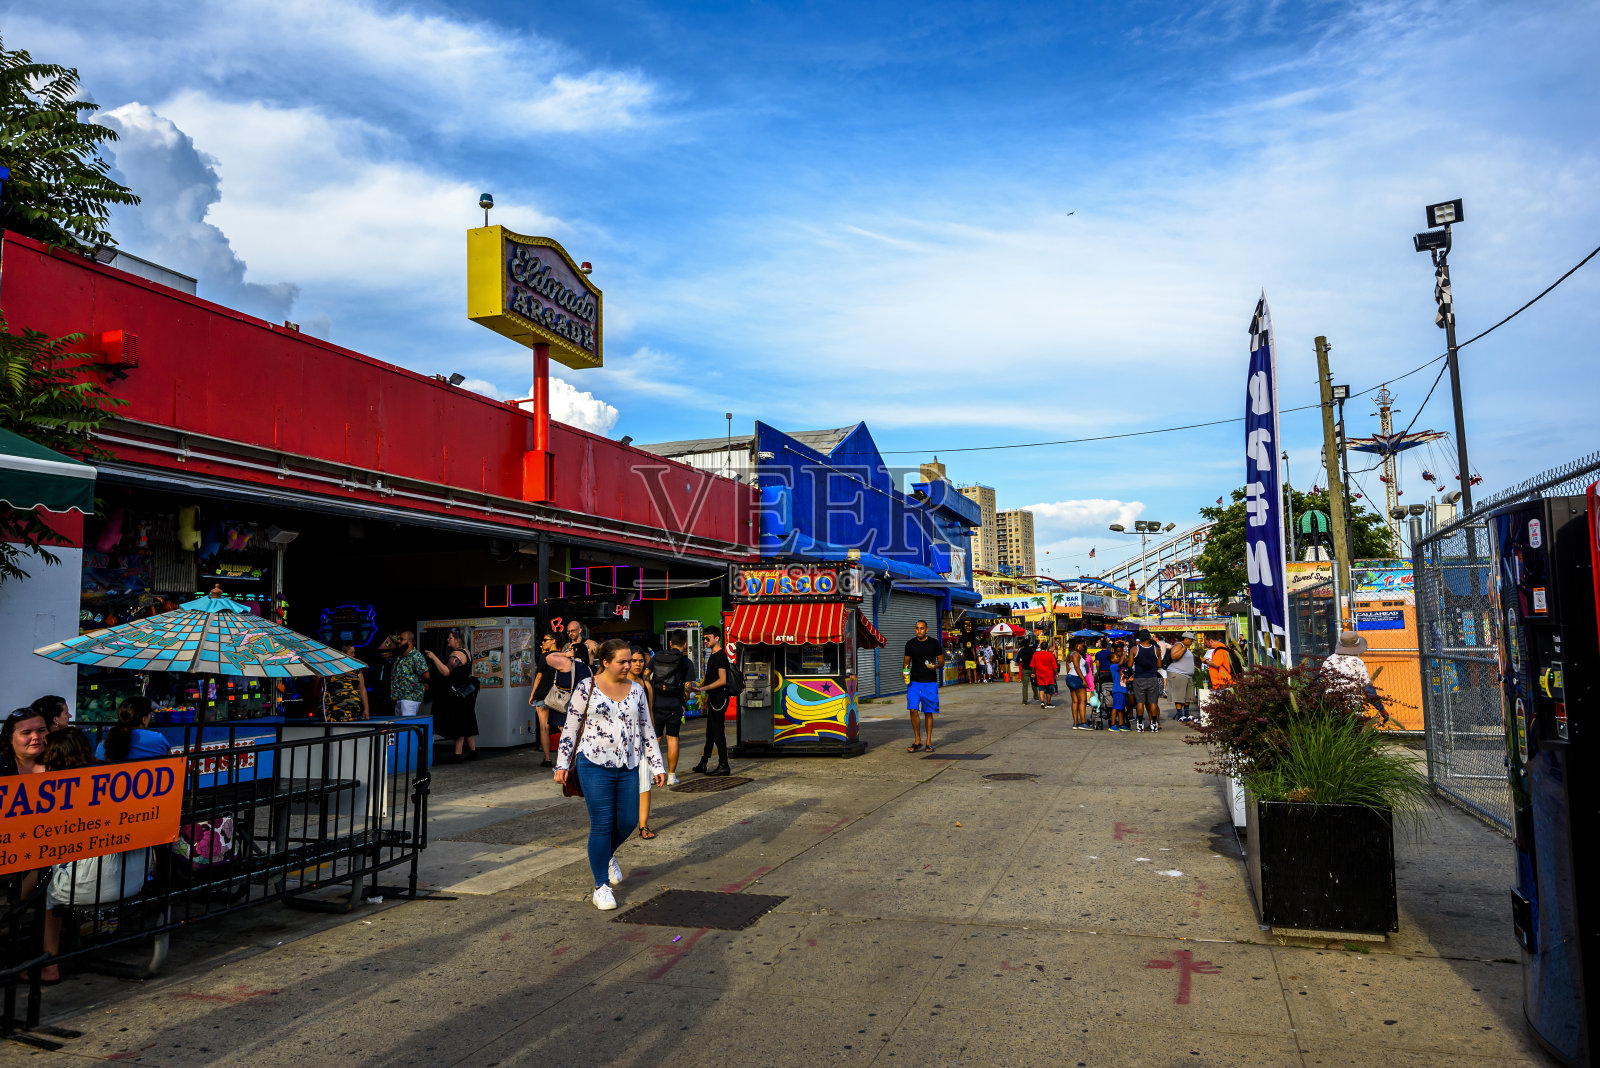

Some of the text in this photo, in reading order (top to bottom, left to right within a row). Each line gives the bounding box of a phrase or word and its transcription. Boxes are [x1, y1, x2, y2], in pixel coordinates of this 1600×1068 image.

[510, 244, 595, 322] Eldorado
[513, 286, 594, 351] ARCADE
[745, 576, 832, 595] DISCO
[88, 766, 175, 807] FOOD
[33, 818, 101, 839] Ceviches
[119, 806, 160, 825] Pernil
[38, 842, 83, 860] Papas
[89, 833, 131, 850] Fritas
